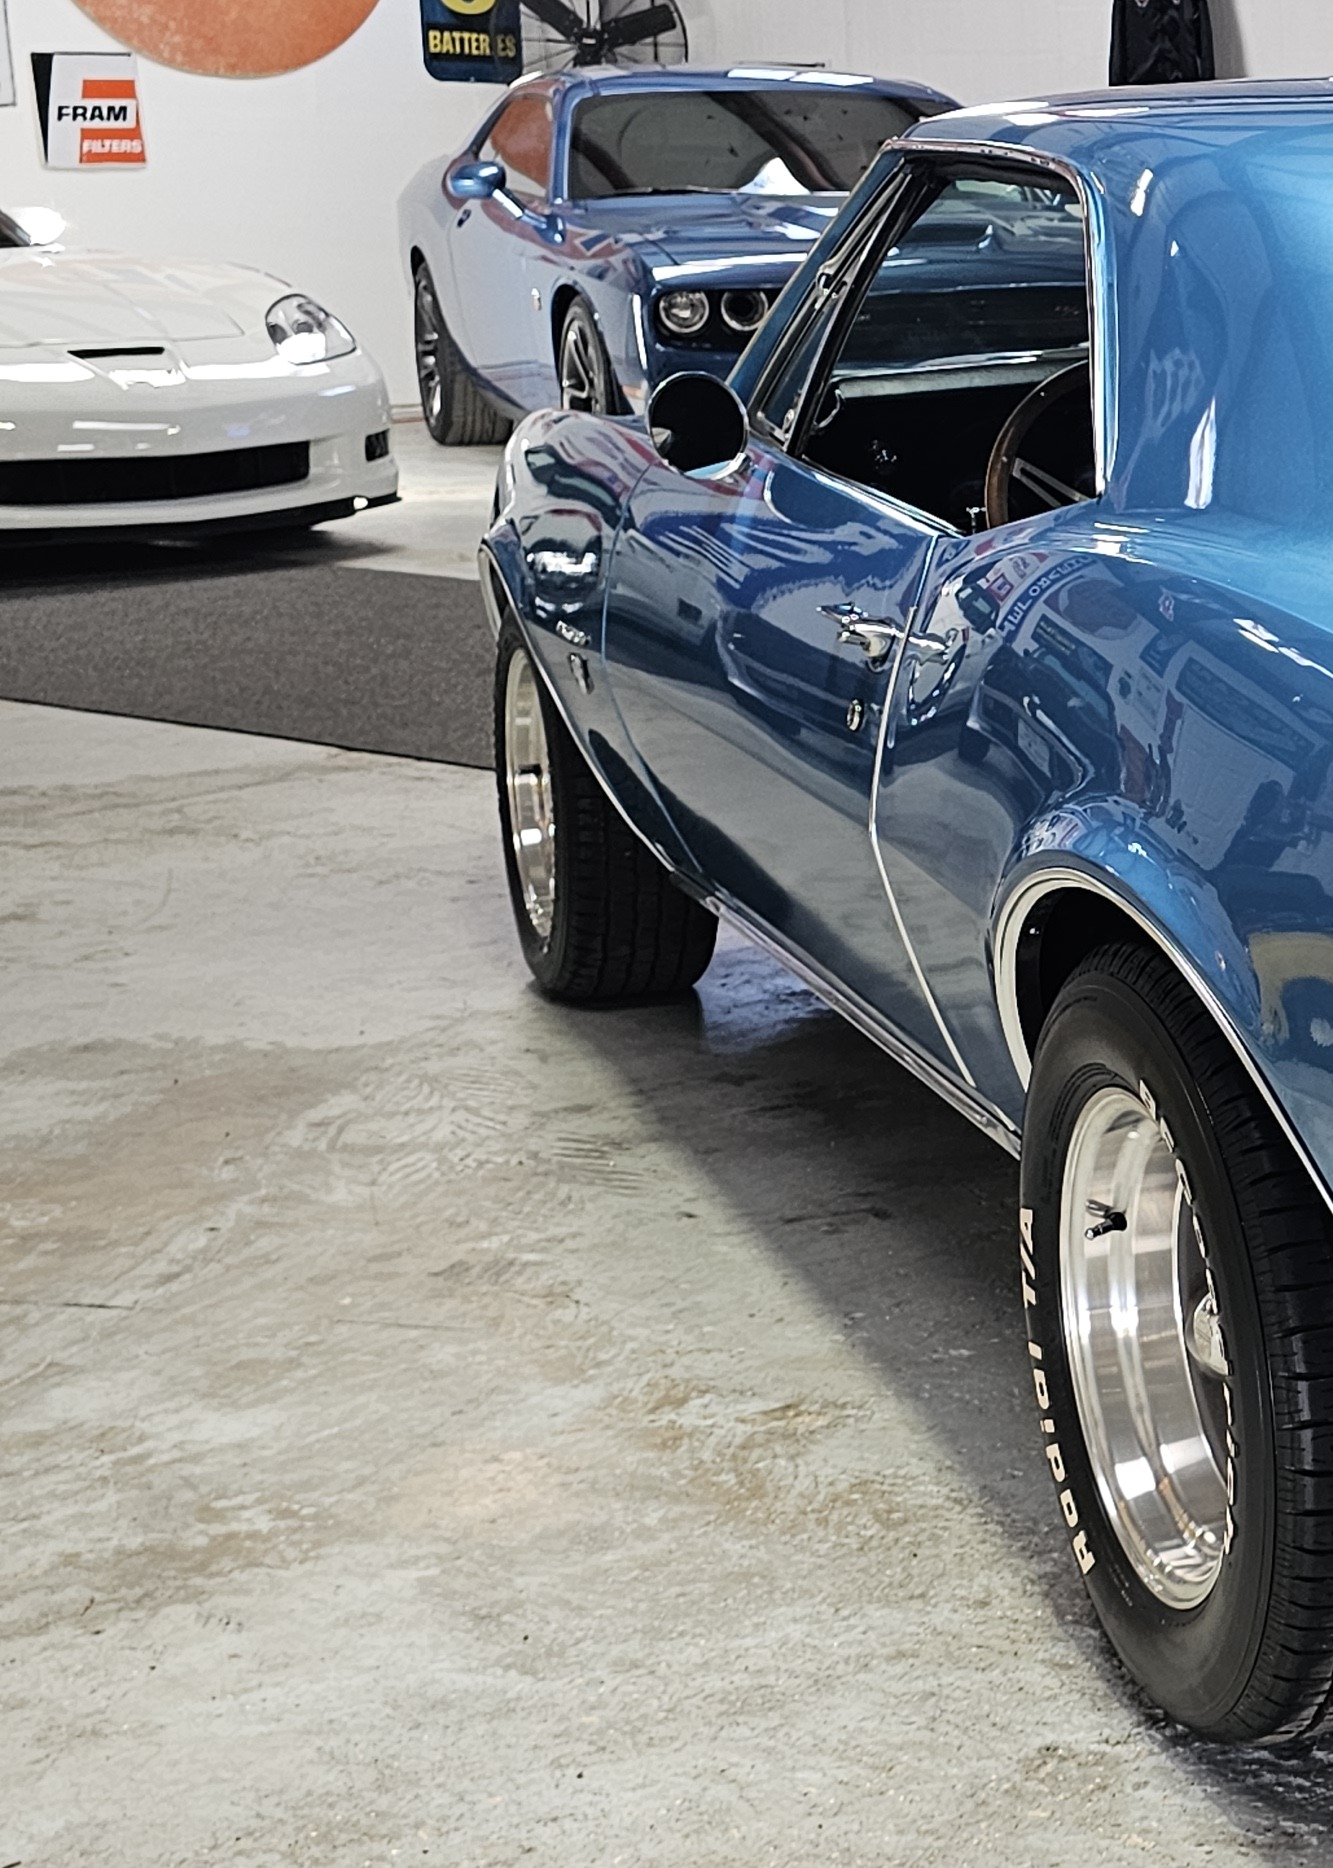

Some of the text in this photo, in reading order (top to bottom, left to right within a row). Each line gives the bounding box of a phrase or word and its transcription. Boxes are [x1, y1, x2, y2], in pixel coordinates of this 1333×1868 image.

[427, 29, 517, 58] BATTERES
[57, 105, 128, 122] FRAM
[81, 138, 142, 155] FILTERS
